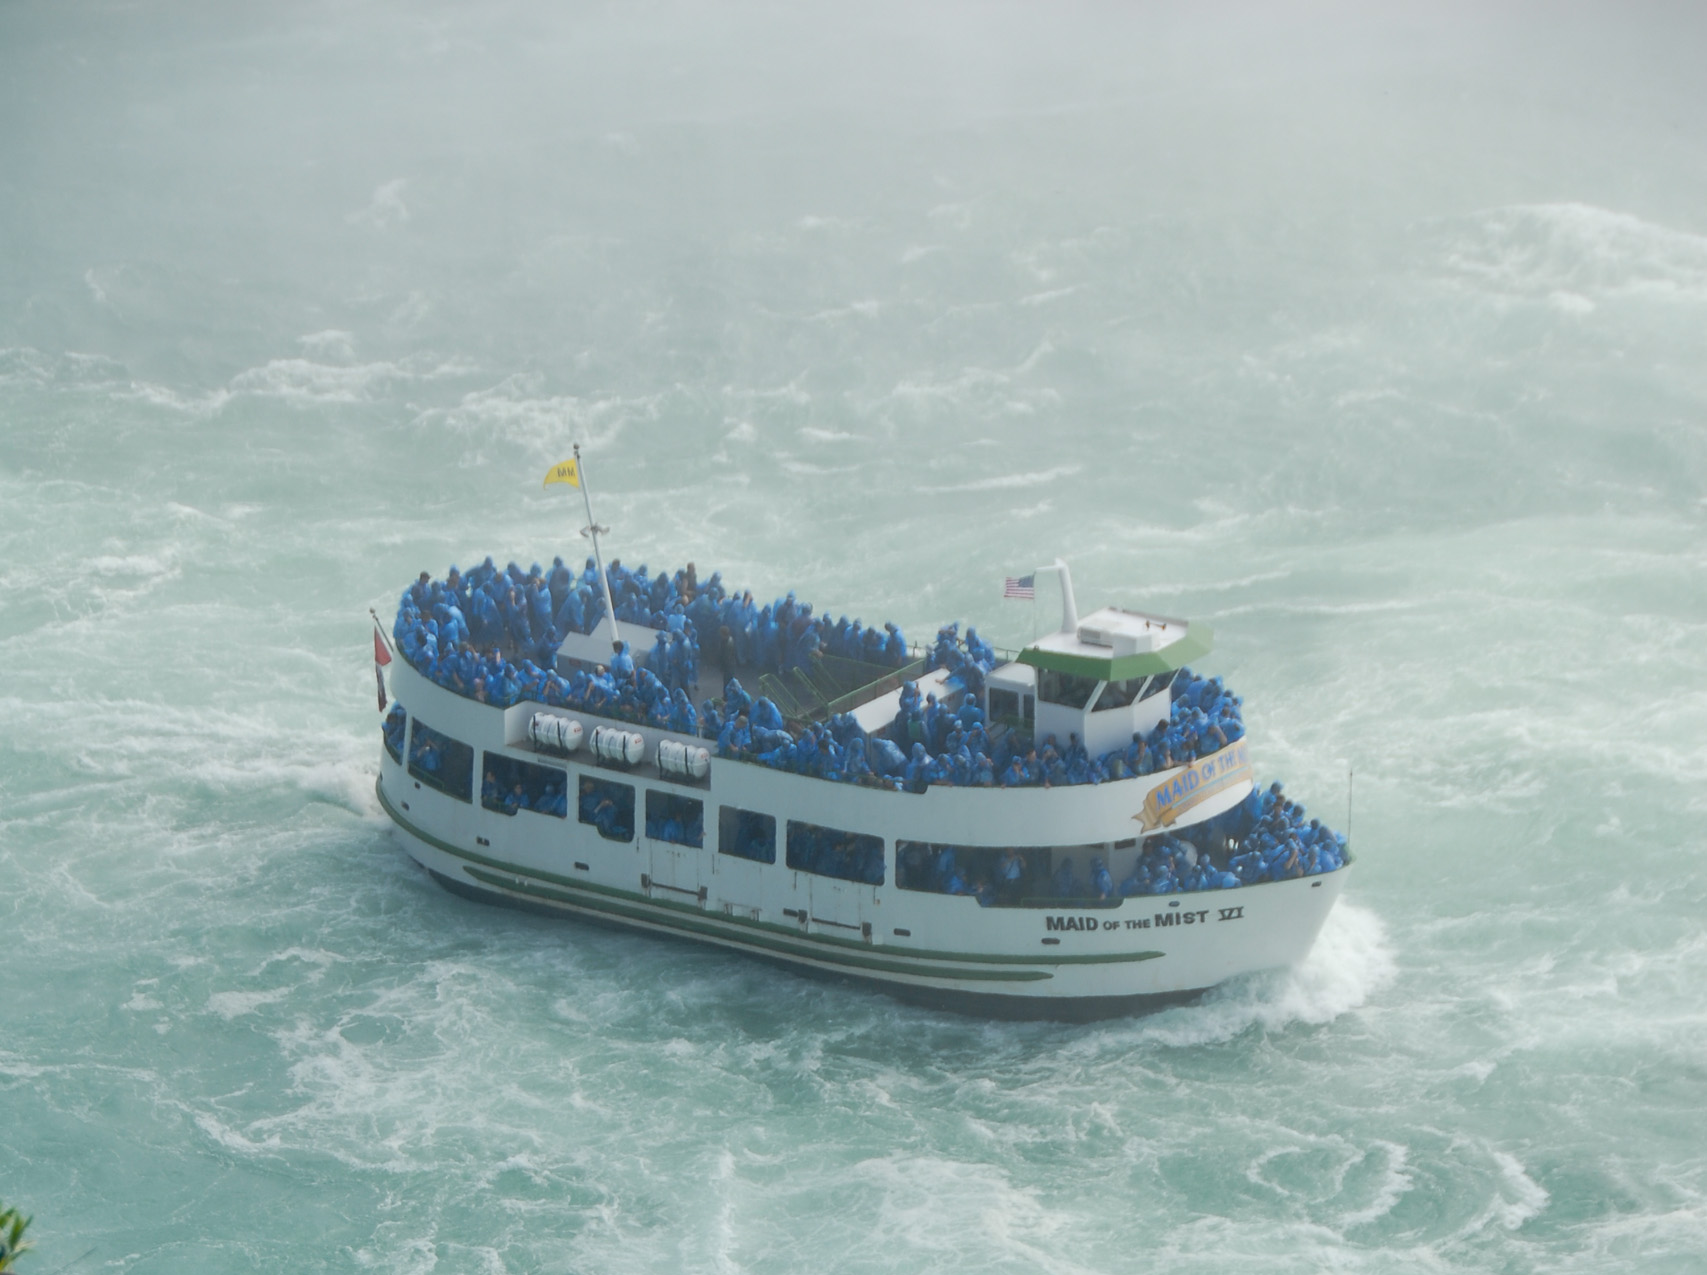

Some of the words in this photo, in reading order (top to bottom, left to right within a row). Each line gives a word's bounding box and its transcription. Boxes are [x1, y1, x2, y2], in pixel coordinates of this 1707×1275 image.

[1155, 769, 1199, 811] MAID
[1046, 916, 1098, 931] MAID
[1103, 920, 1120, 930] OF
[1124, 918, 1150, 930] THE
[1154, 909, 1209, 927] MIST
[1218, 906, 1244, 922] VI
